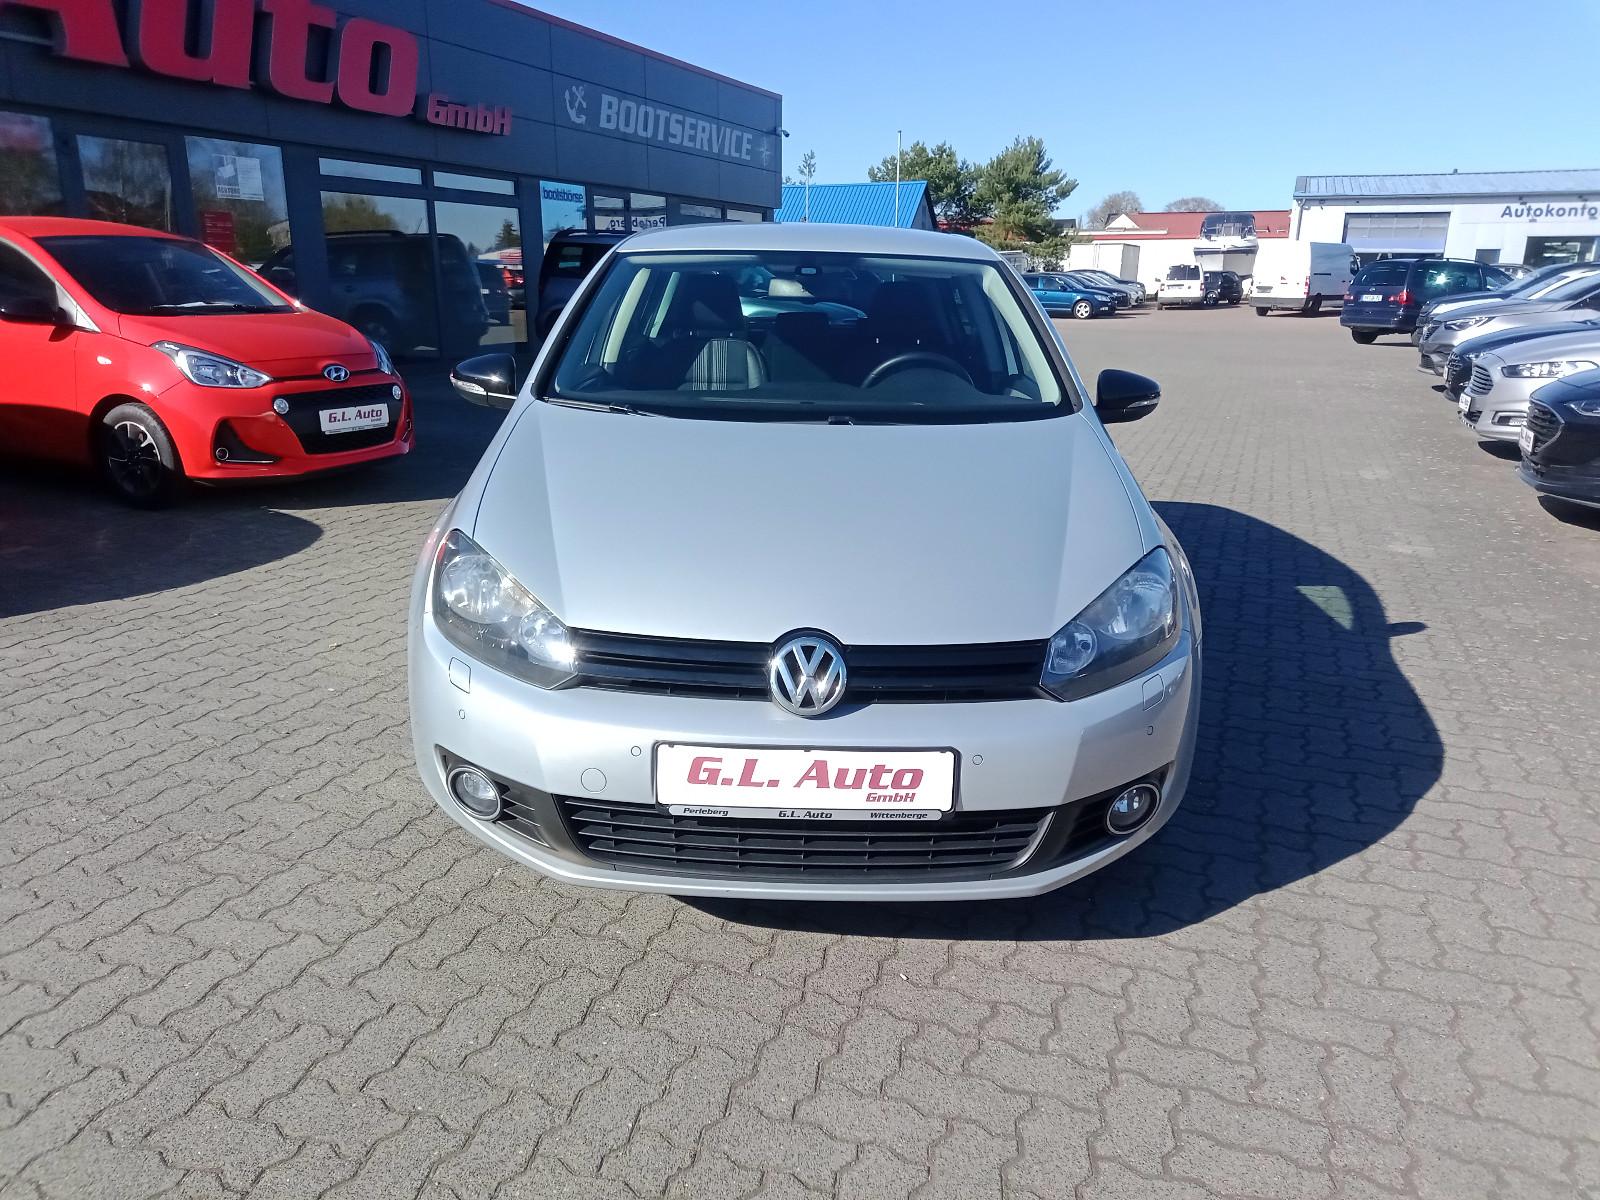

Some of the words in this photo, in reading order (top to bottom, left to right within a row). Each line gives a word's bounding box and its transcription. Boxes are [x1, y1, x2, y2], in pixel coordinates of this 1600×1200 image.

[427, 93, 513, 136] GmbH
[600, 93, 753, 161] BOOTSERVICE
[328, 411, 351, 424] G.L.
[355, 408, 383, 421] Auto
[687, 756, 780, 788] G.L.
[793, 759, 924, 790] Auto
[866, 792, 916, 803] GmbH
[683, 807, 729, 817] Perleberg
[778, 810, 801, 819] G.L.
[803, 810, 833, 819] Auto
[870, 812, 928, 820] Wittenberge
